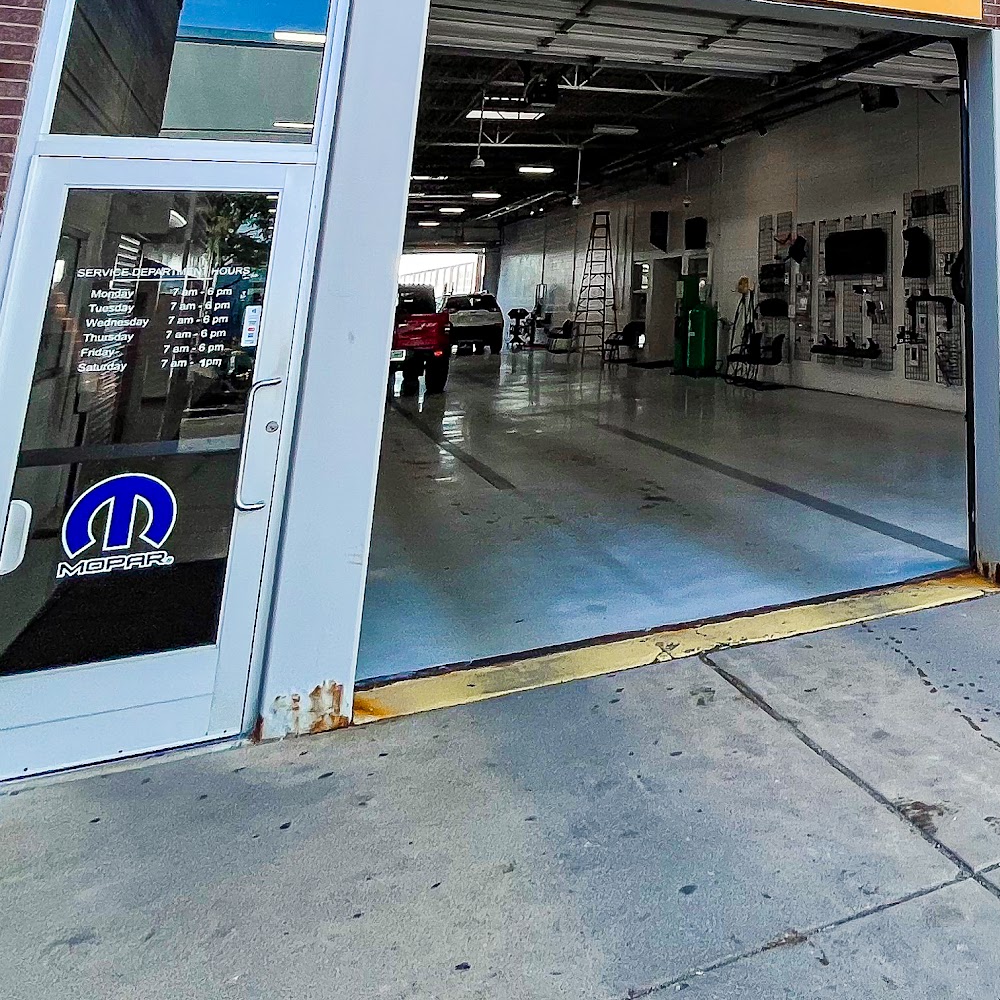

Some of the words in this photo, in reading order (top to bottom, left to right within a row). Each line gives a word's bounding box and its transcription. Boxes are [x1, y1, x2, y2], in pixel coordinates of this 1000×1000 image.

[77, 268, 129, 278] SERVICE
[131, 267, 205, 277] DEPARTMENT
[212, 266, 250, 276] HOURS
[91, 289, 135, 299] Monday
[172, 287, 180, 296] 7
[183, 288, 198, 296] am
[207, 287, 214, 295] 6
[216, 288, 232, 297] pm
[88, 303, 135, 313] Tuesday
[170, 301, 178, 310] 7
[205, 301, 212, 309] 6
[214, 301, 230, 311] pm
[85, 317, 150, 328] Wednesday
[168, 315, 175, 324] 7
[203, 314, 210, 323] 6
[212, 315, 228, 325] pm
[83, 332, 135, 343] Thursday
[165, 330, 173, 339] 7
[175, 331, 191, 339] am
[201, 329, 208, 337] 6
[210, 329, 226, 339] pm
[80, 347, 115, 357] Friday
[163, 344, 171, 353] 7
[199, 343, 206, 352] 6
[208, 344, 224, 353] pm
[77, 363, 127, 373] Saturday
[161, 359, 168, 368] 7
[171, 360, 187, 368] am
[56, 551, 169, 578] MOPAR
